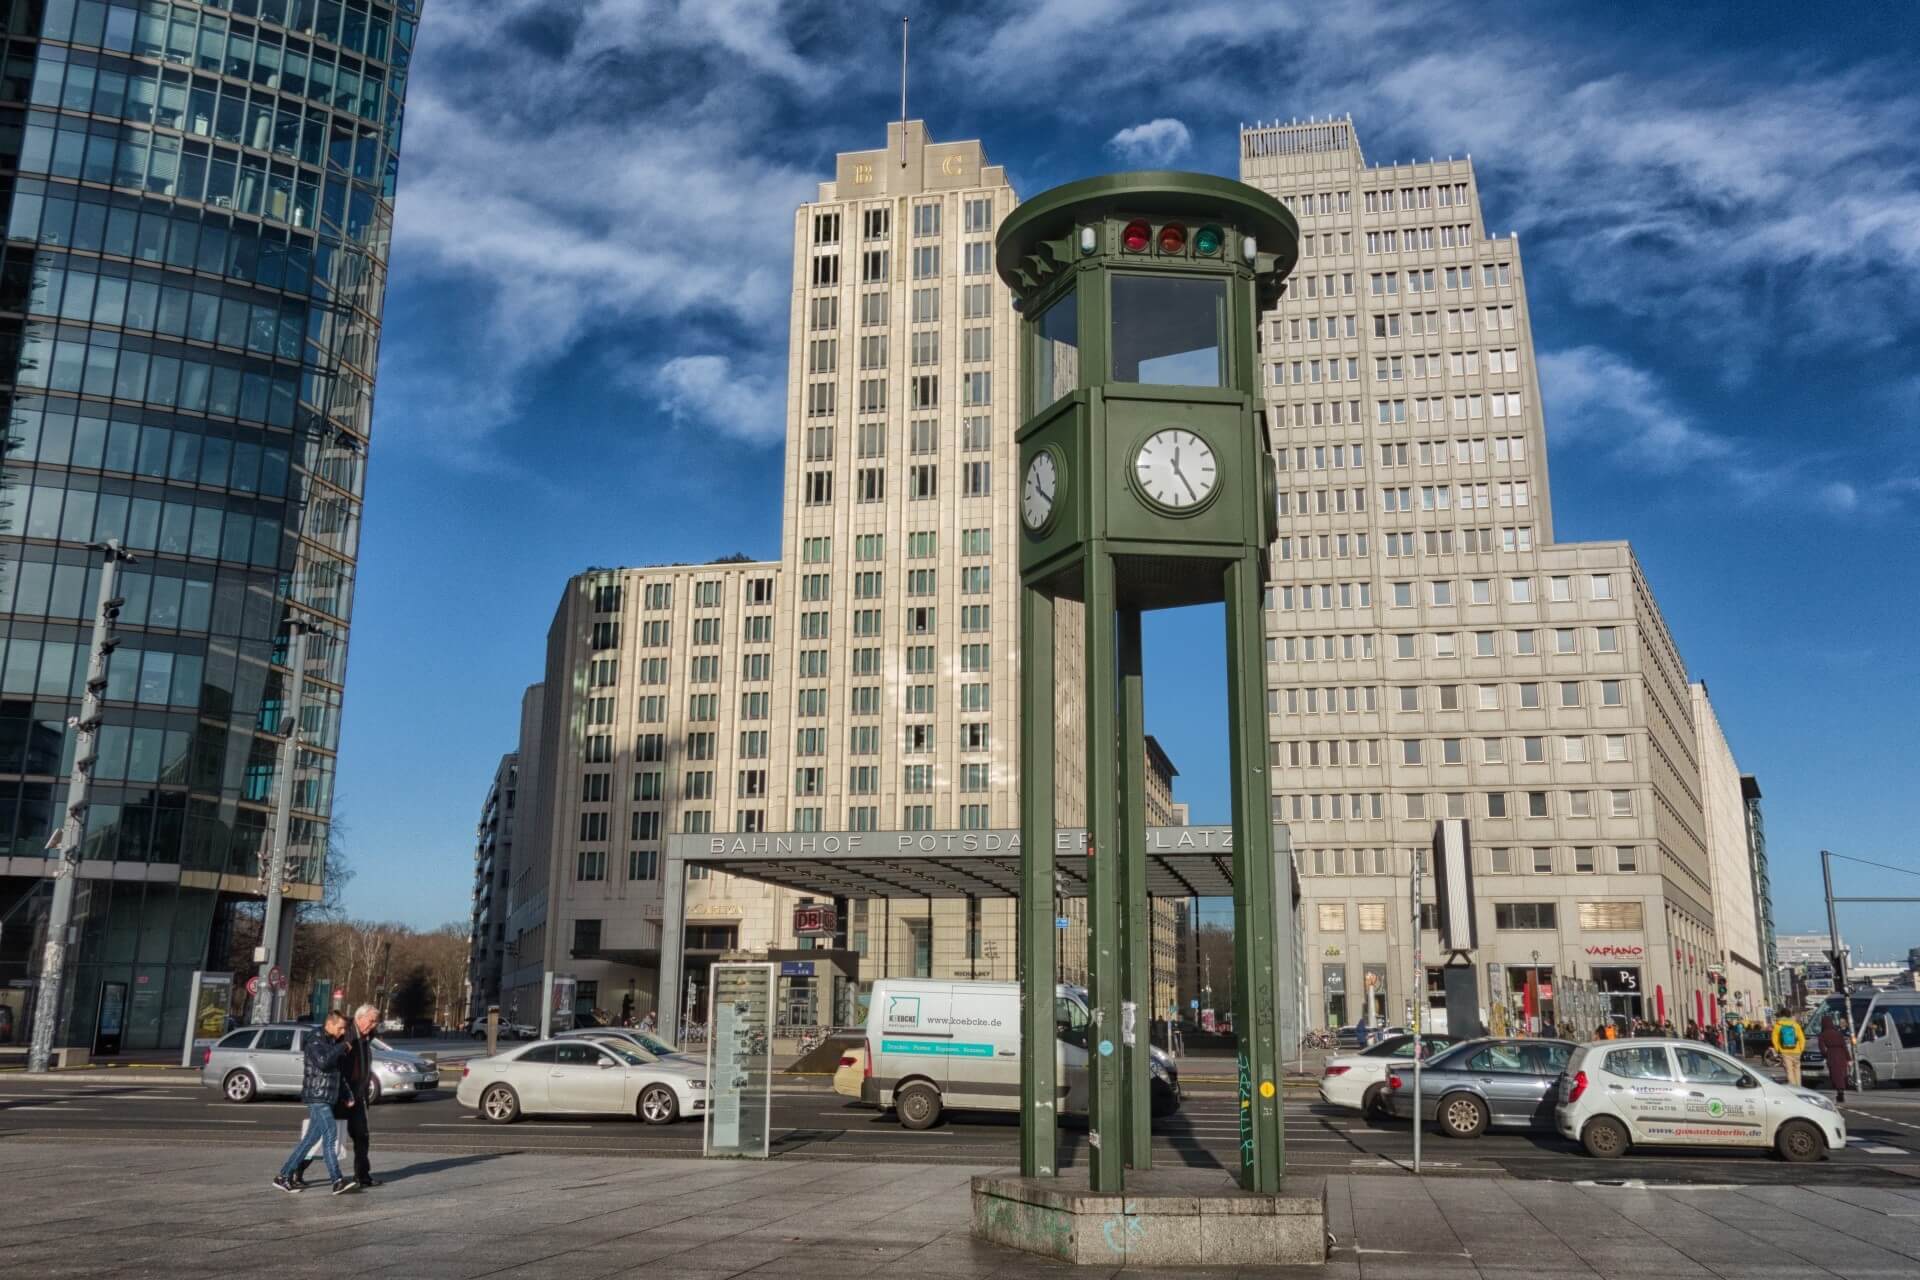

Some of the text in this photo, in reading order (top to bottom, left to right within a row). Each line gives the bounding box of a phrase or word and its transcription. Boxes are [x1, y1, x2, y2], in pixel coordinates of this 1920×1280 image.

[710, 829, 1232, 854] BAHNHOF POTSDAE LATZ
[798, 911, 819, 928] DB
[927, 1016, 1002, 1027] www.koebcke.de
